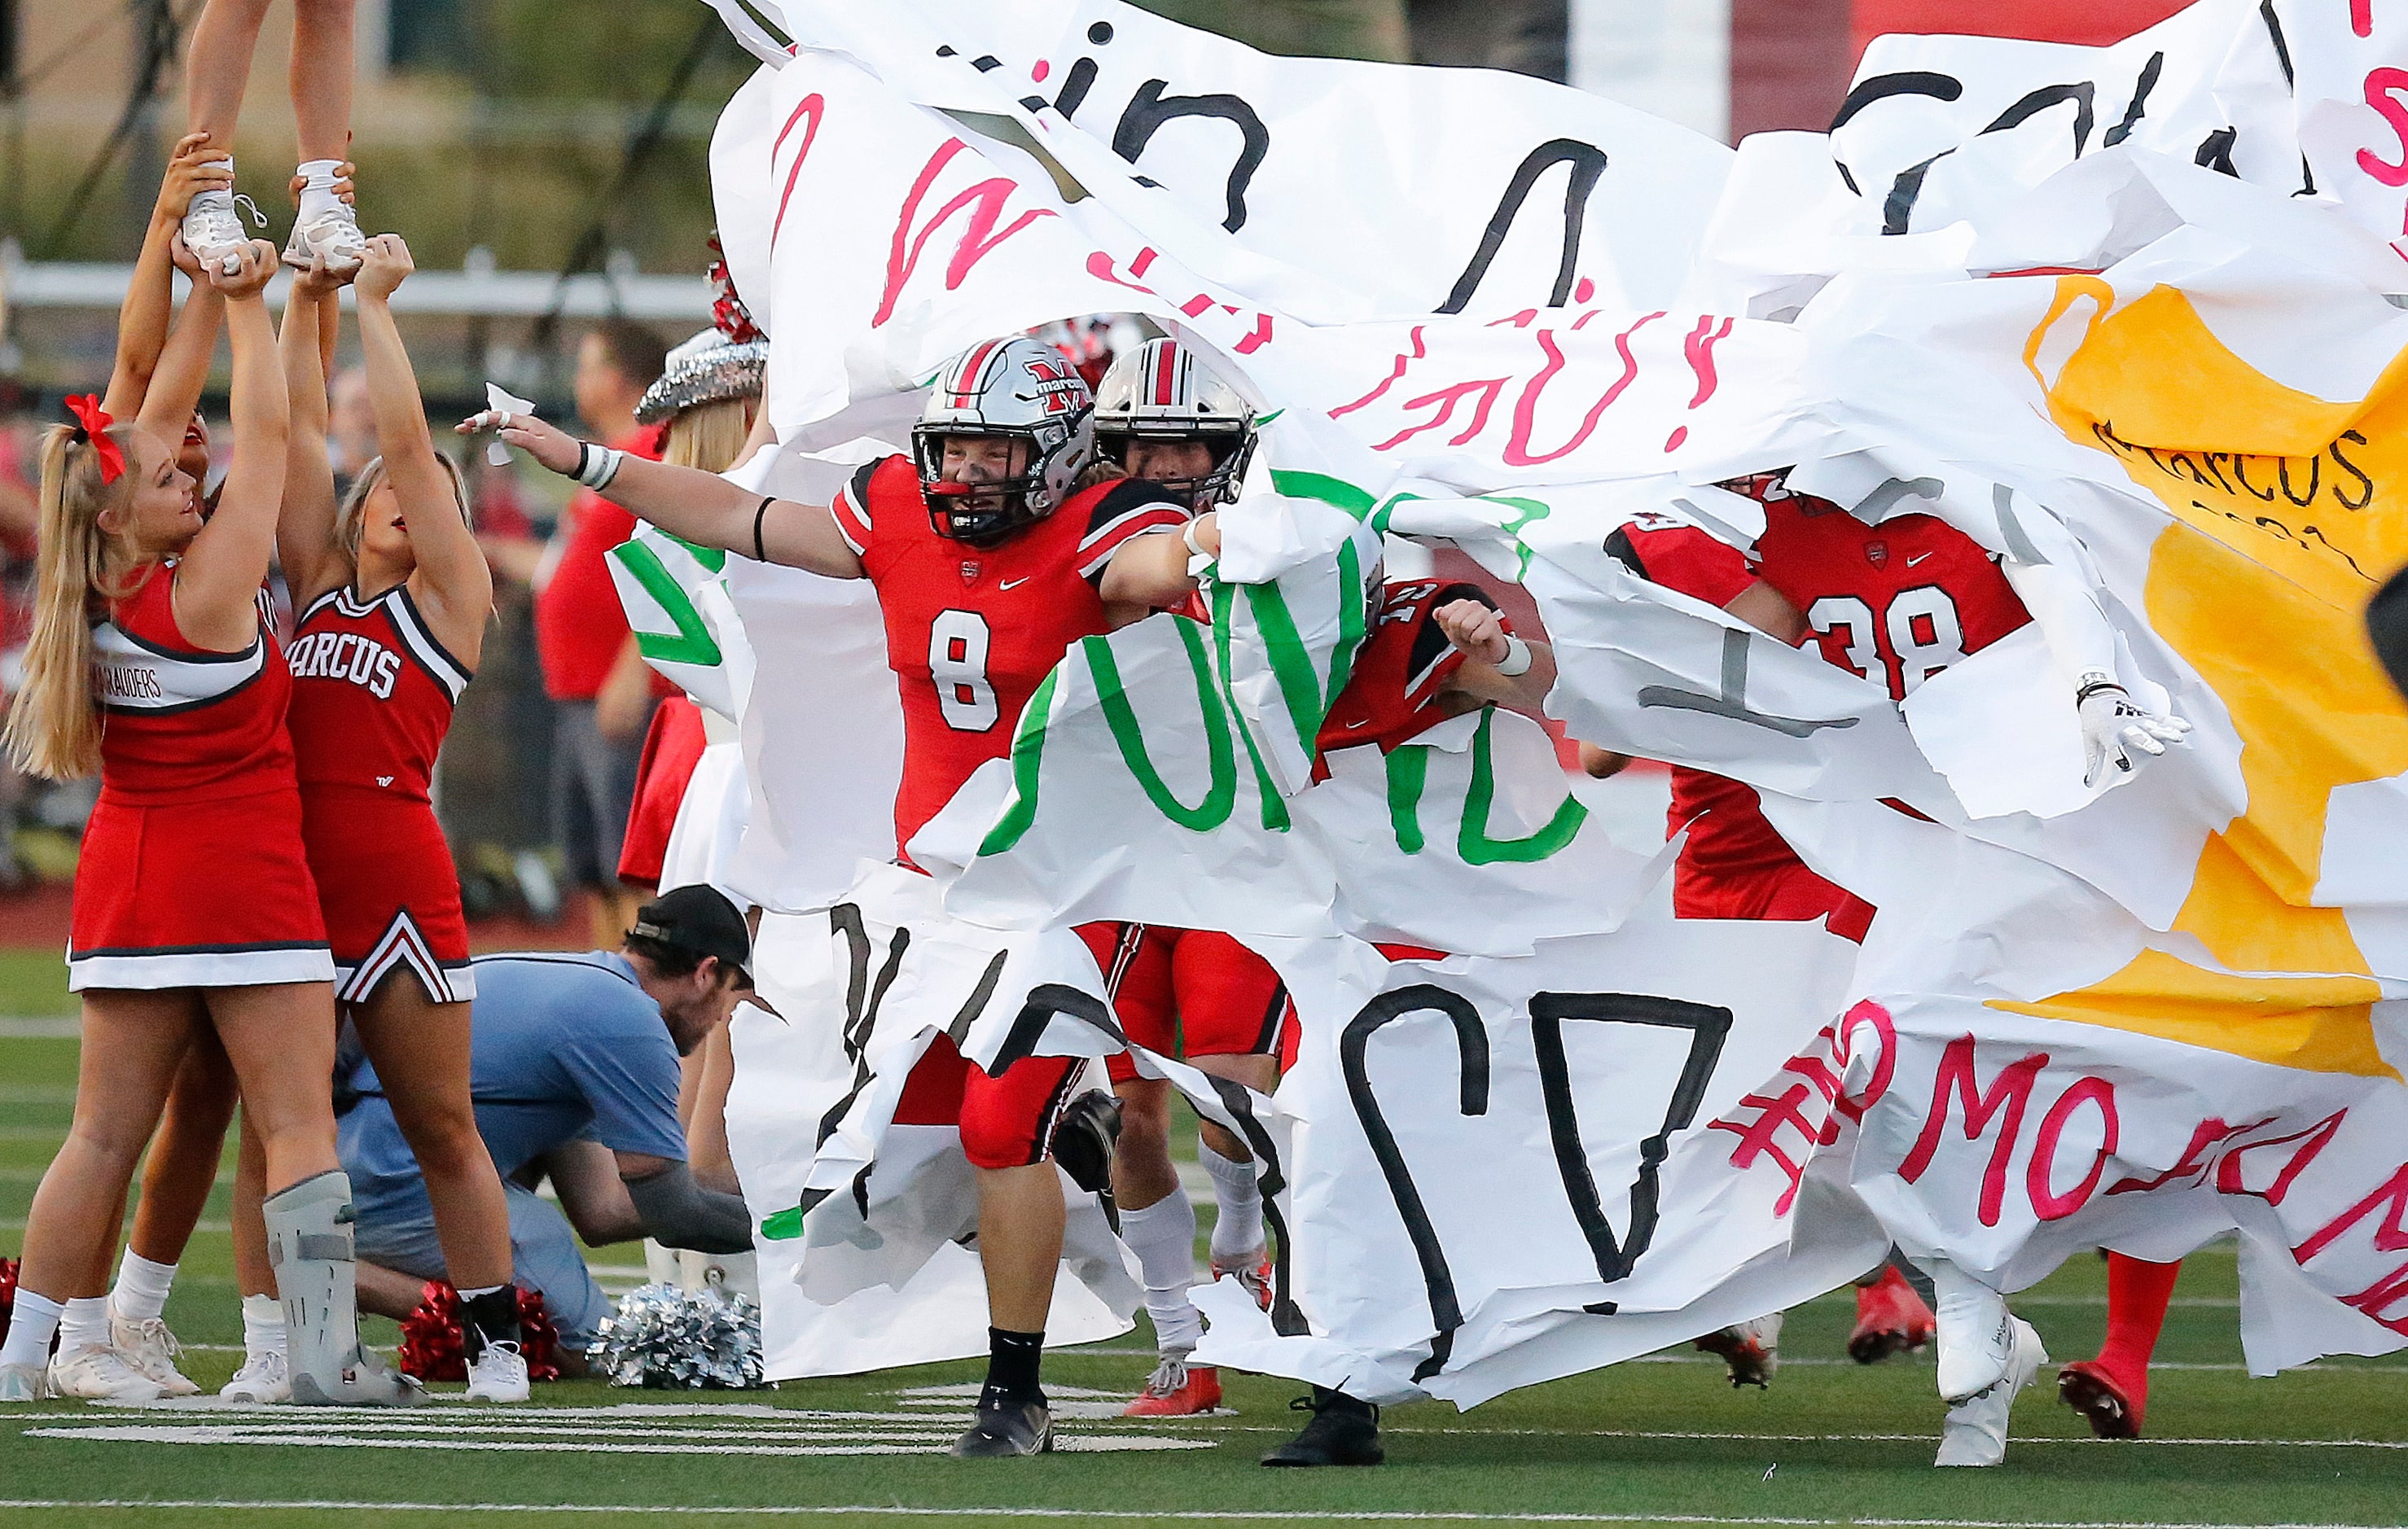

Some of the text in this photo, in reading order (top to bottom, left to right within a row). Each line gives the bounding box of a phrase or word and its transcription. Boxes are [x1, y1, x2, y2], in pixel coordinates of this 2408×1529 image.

[1036, 378, 1086, 394] marcu
[283, 632, 402, 700] ARCUS
[928, 608, 999, 732] 8
[1807, 584, 1965, 705] 38
